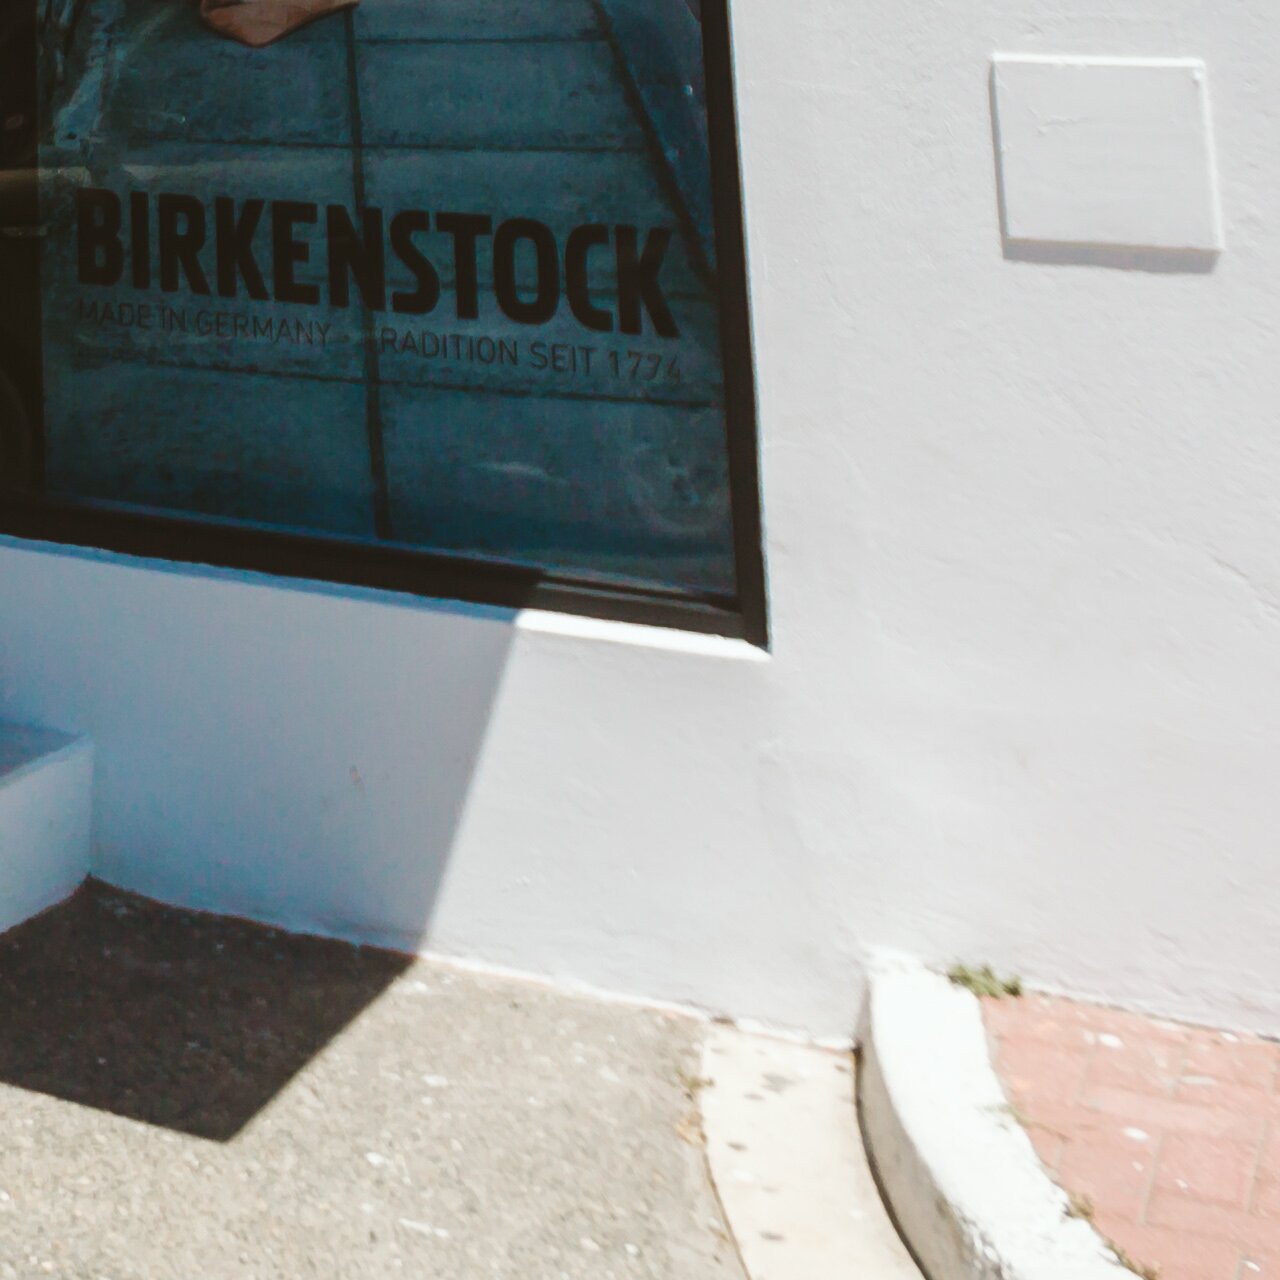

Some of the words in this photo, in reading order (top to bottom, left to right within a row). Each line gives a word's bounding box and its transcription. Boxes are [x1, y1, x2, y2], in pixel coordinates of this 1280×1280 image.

[75, 186, 680, 339] BIRKENSTOCK
[78, 297, 150, 330] MADE
[158, 302, 187, 332] IN
[196, 309, 332, 347] GERMANY
[529, 341, 596, 377] SEIT
